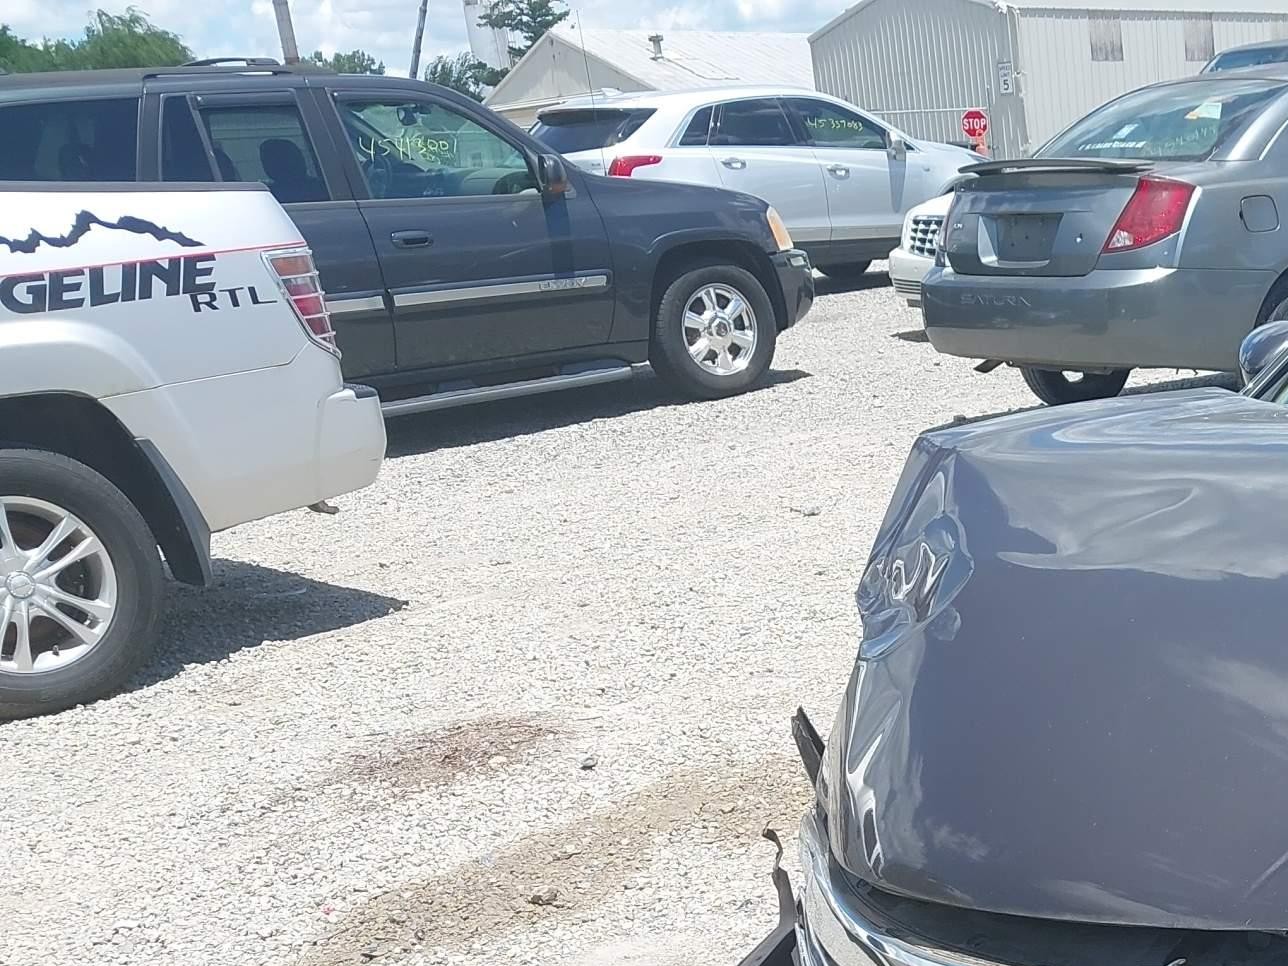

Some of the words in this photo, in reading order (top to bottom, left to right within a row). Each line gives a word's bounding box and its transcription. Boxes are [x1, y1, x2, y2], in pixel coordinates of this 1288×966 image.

[1003, 79, 1010, 91] 5
[963, 118, 987, 130] STOP
[190, 286, 278, 313] RTL
